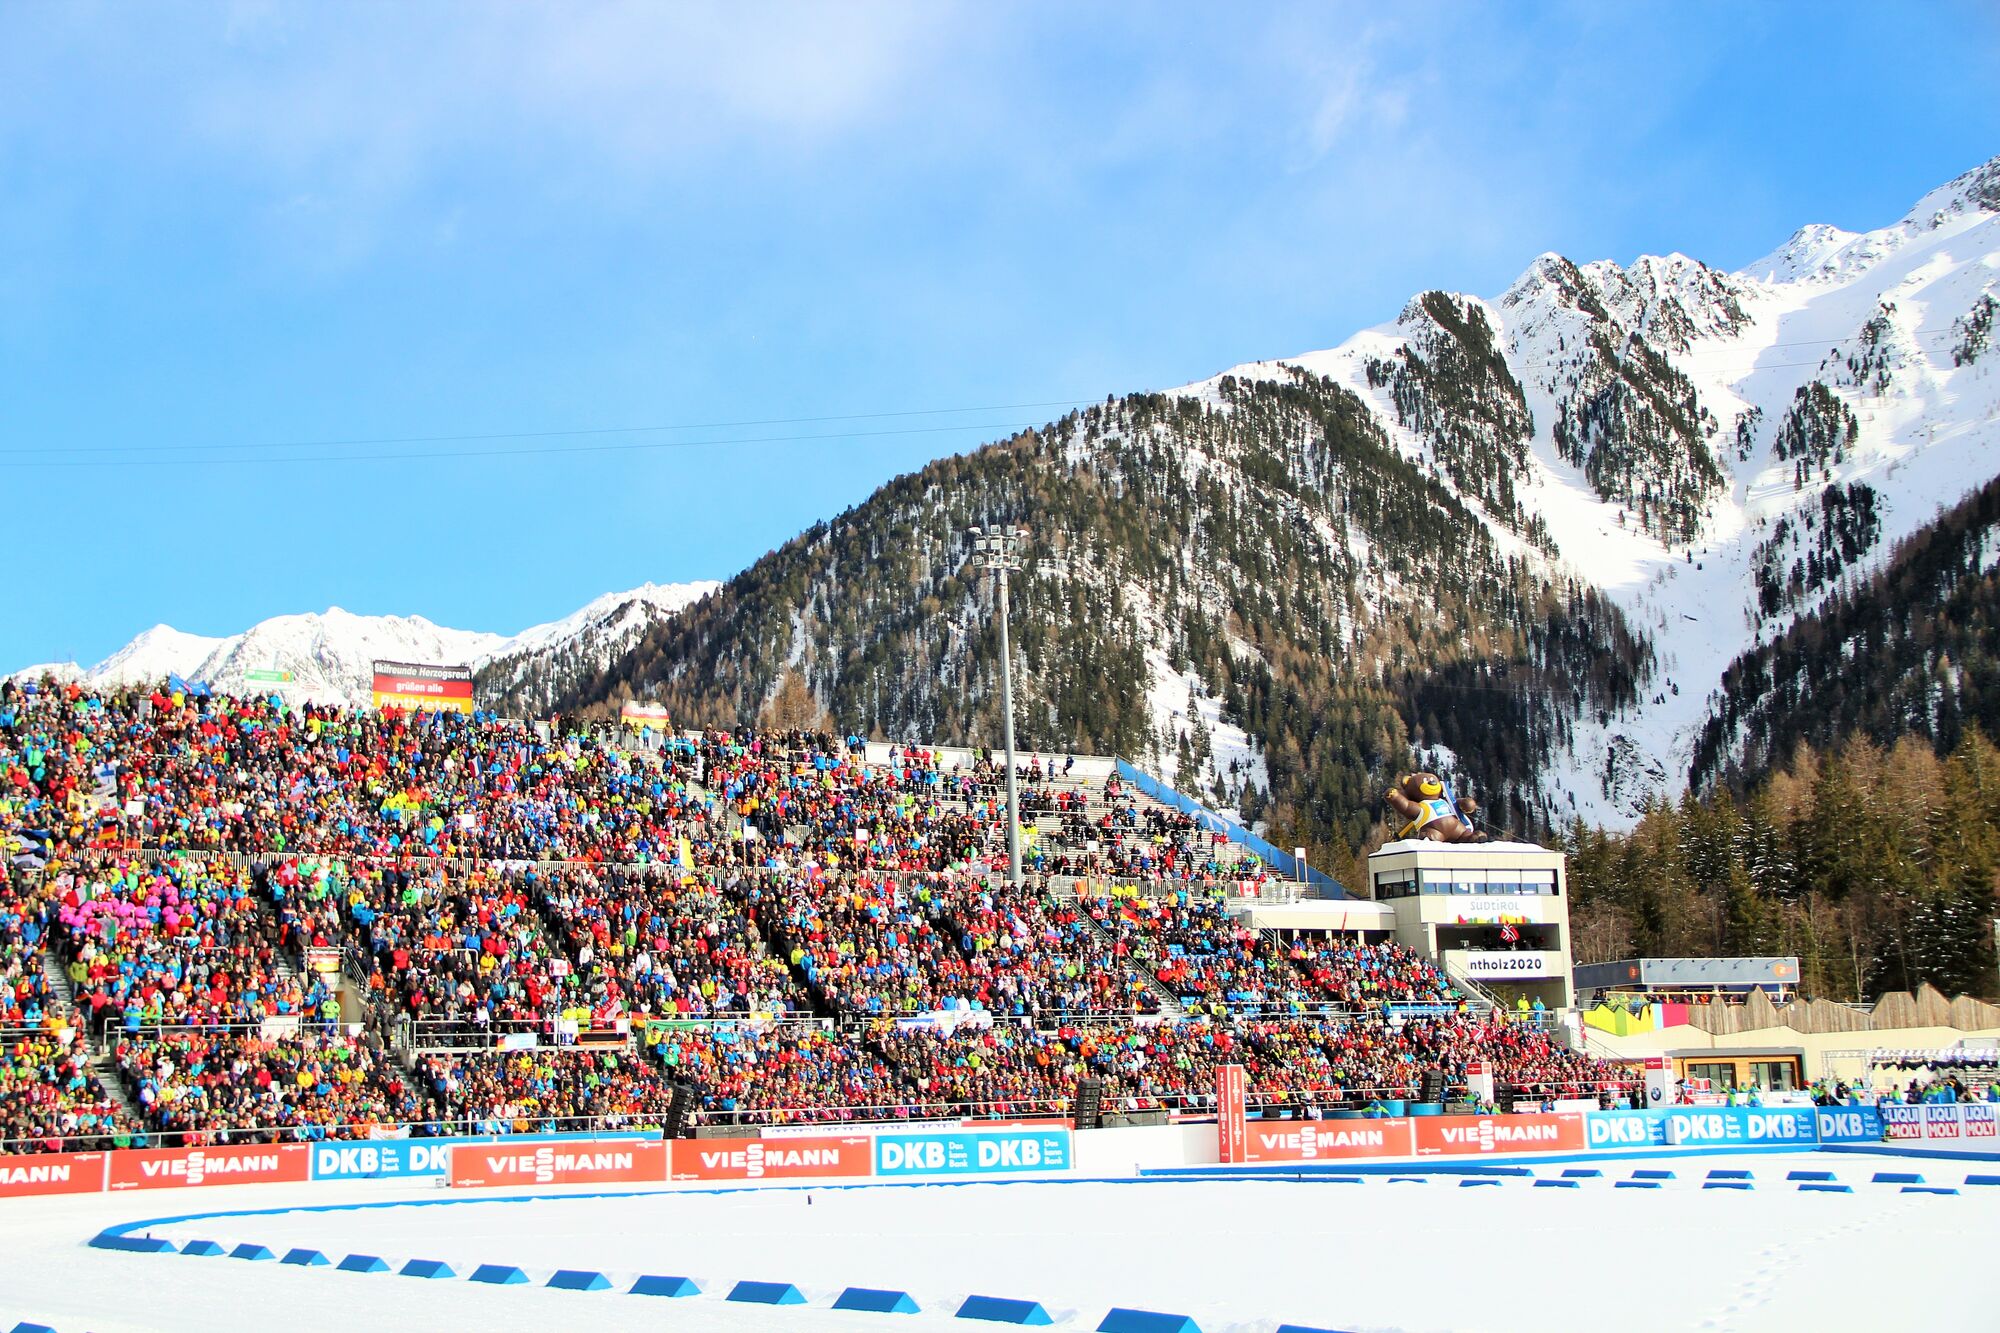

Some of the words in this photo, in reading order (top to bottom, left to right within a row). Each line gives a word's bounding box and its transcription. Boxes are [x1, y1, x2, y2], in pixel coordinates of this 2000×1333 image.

[374, 662, 418, 676] Skifreunde
[419, 667, 471, 681] Herzogsreut
[396, 681, 426, 693] grüßen
[427, 684, 444, 693] alle
[1747, 1113, 1797, 1139] DKB
[1820, 1113, 1864, 1137] DKB
[1887, 1107, 1920, 1123] LIQUI
[1927, 1106, 1958, 1122] LIQUI
[1964, 1105, 1994, 1121] LIQUI
[1440, 1119, 1559, 1150] VIESSMANN
[1589, 1117, 1647, 1144] DKB
[1672, 1114, 1725, 1142] DKB
[1890, 1123, 1921, 1138] MOLY
[1928, 1122, 1959, 1137] MOLY
[1966, 1121, 1995, 1136] MOLY
[881, 1141, 946, 1169] DKB
[978, 1139, 1042, 1167] DKB
[1260, 1126, 1384, 1158] VIESSMANN
[141, 1151, 279, 1184] VIESSMANN
[318, 1147, 379, 1175] DKB
[409, 1145, 447, 1171] DK
[487, 1147, 633, 1182] VIESSMANN
[701, 1144, 840, 1177] VIESSMANN
